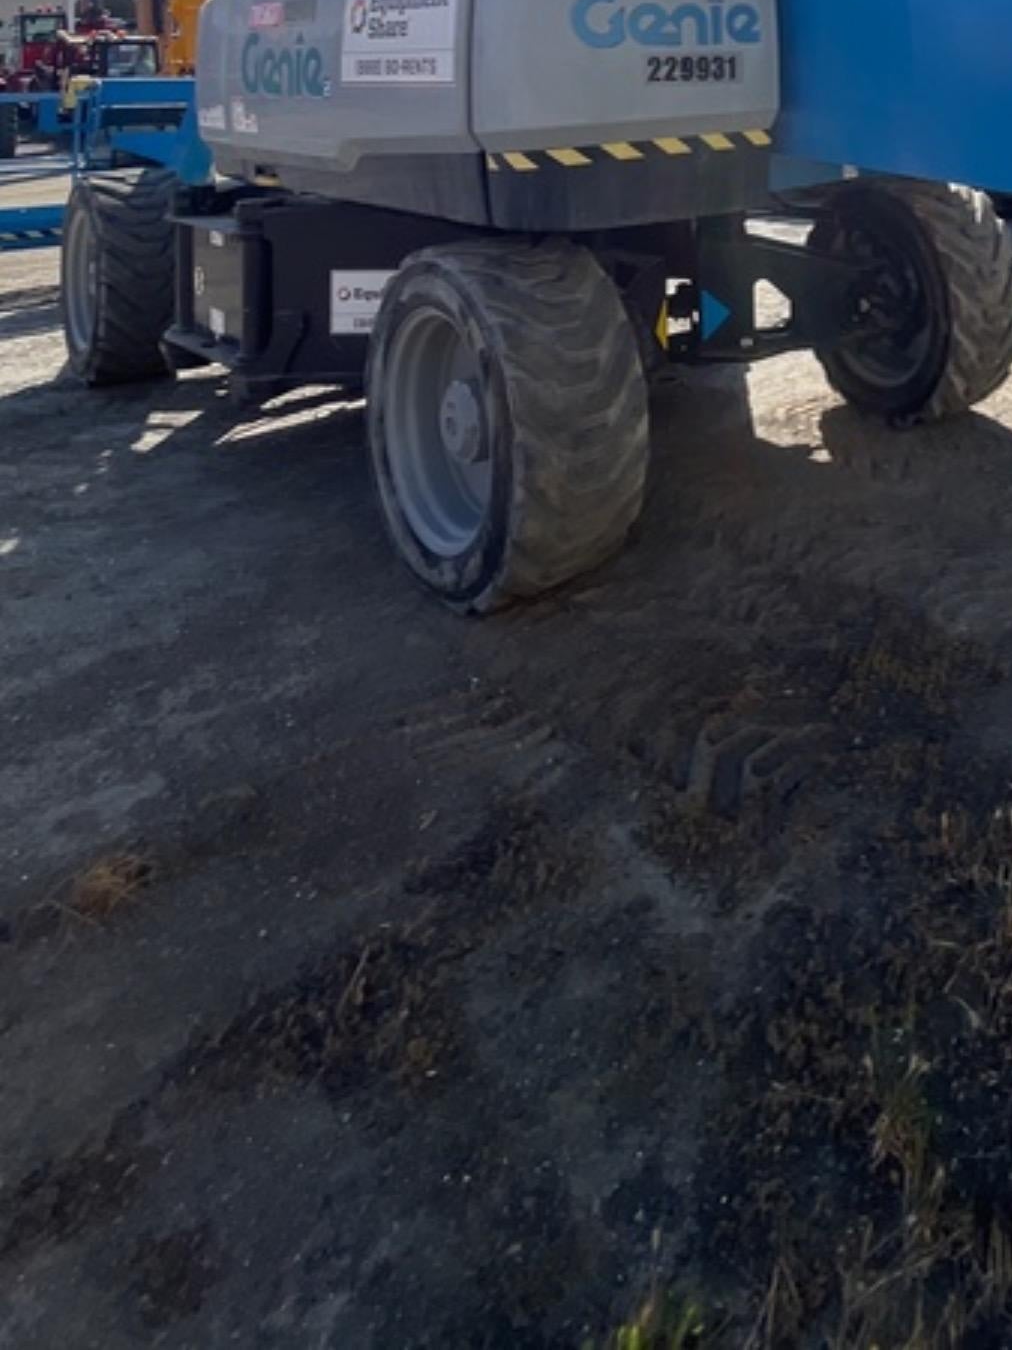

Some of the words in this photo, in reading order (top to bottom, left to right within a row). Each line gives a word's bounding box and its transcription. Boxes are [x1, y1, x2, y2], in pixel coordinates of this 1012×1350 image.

[368, 17, 409, 39] Share
[241, 30, 322, 97] Genie
[646, 55, 737, 83] 229931
